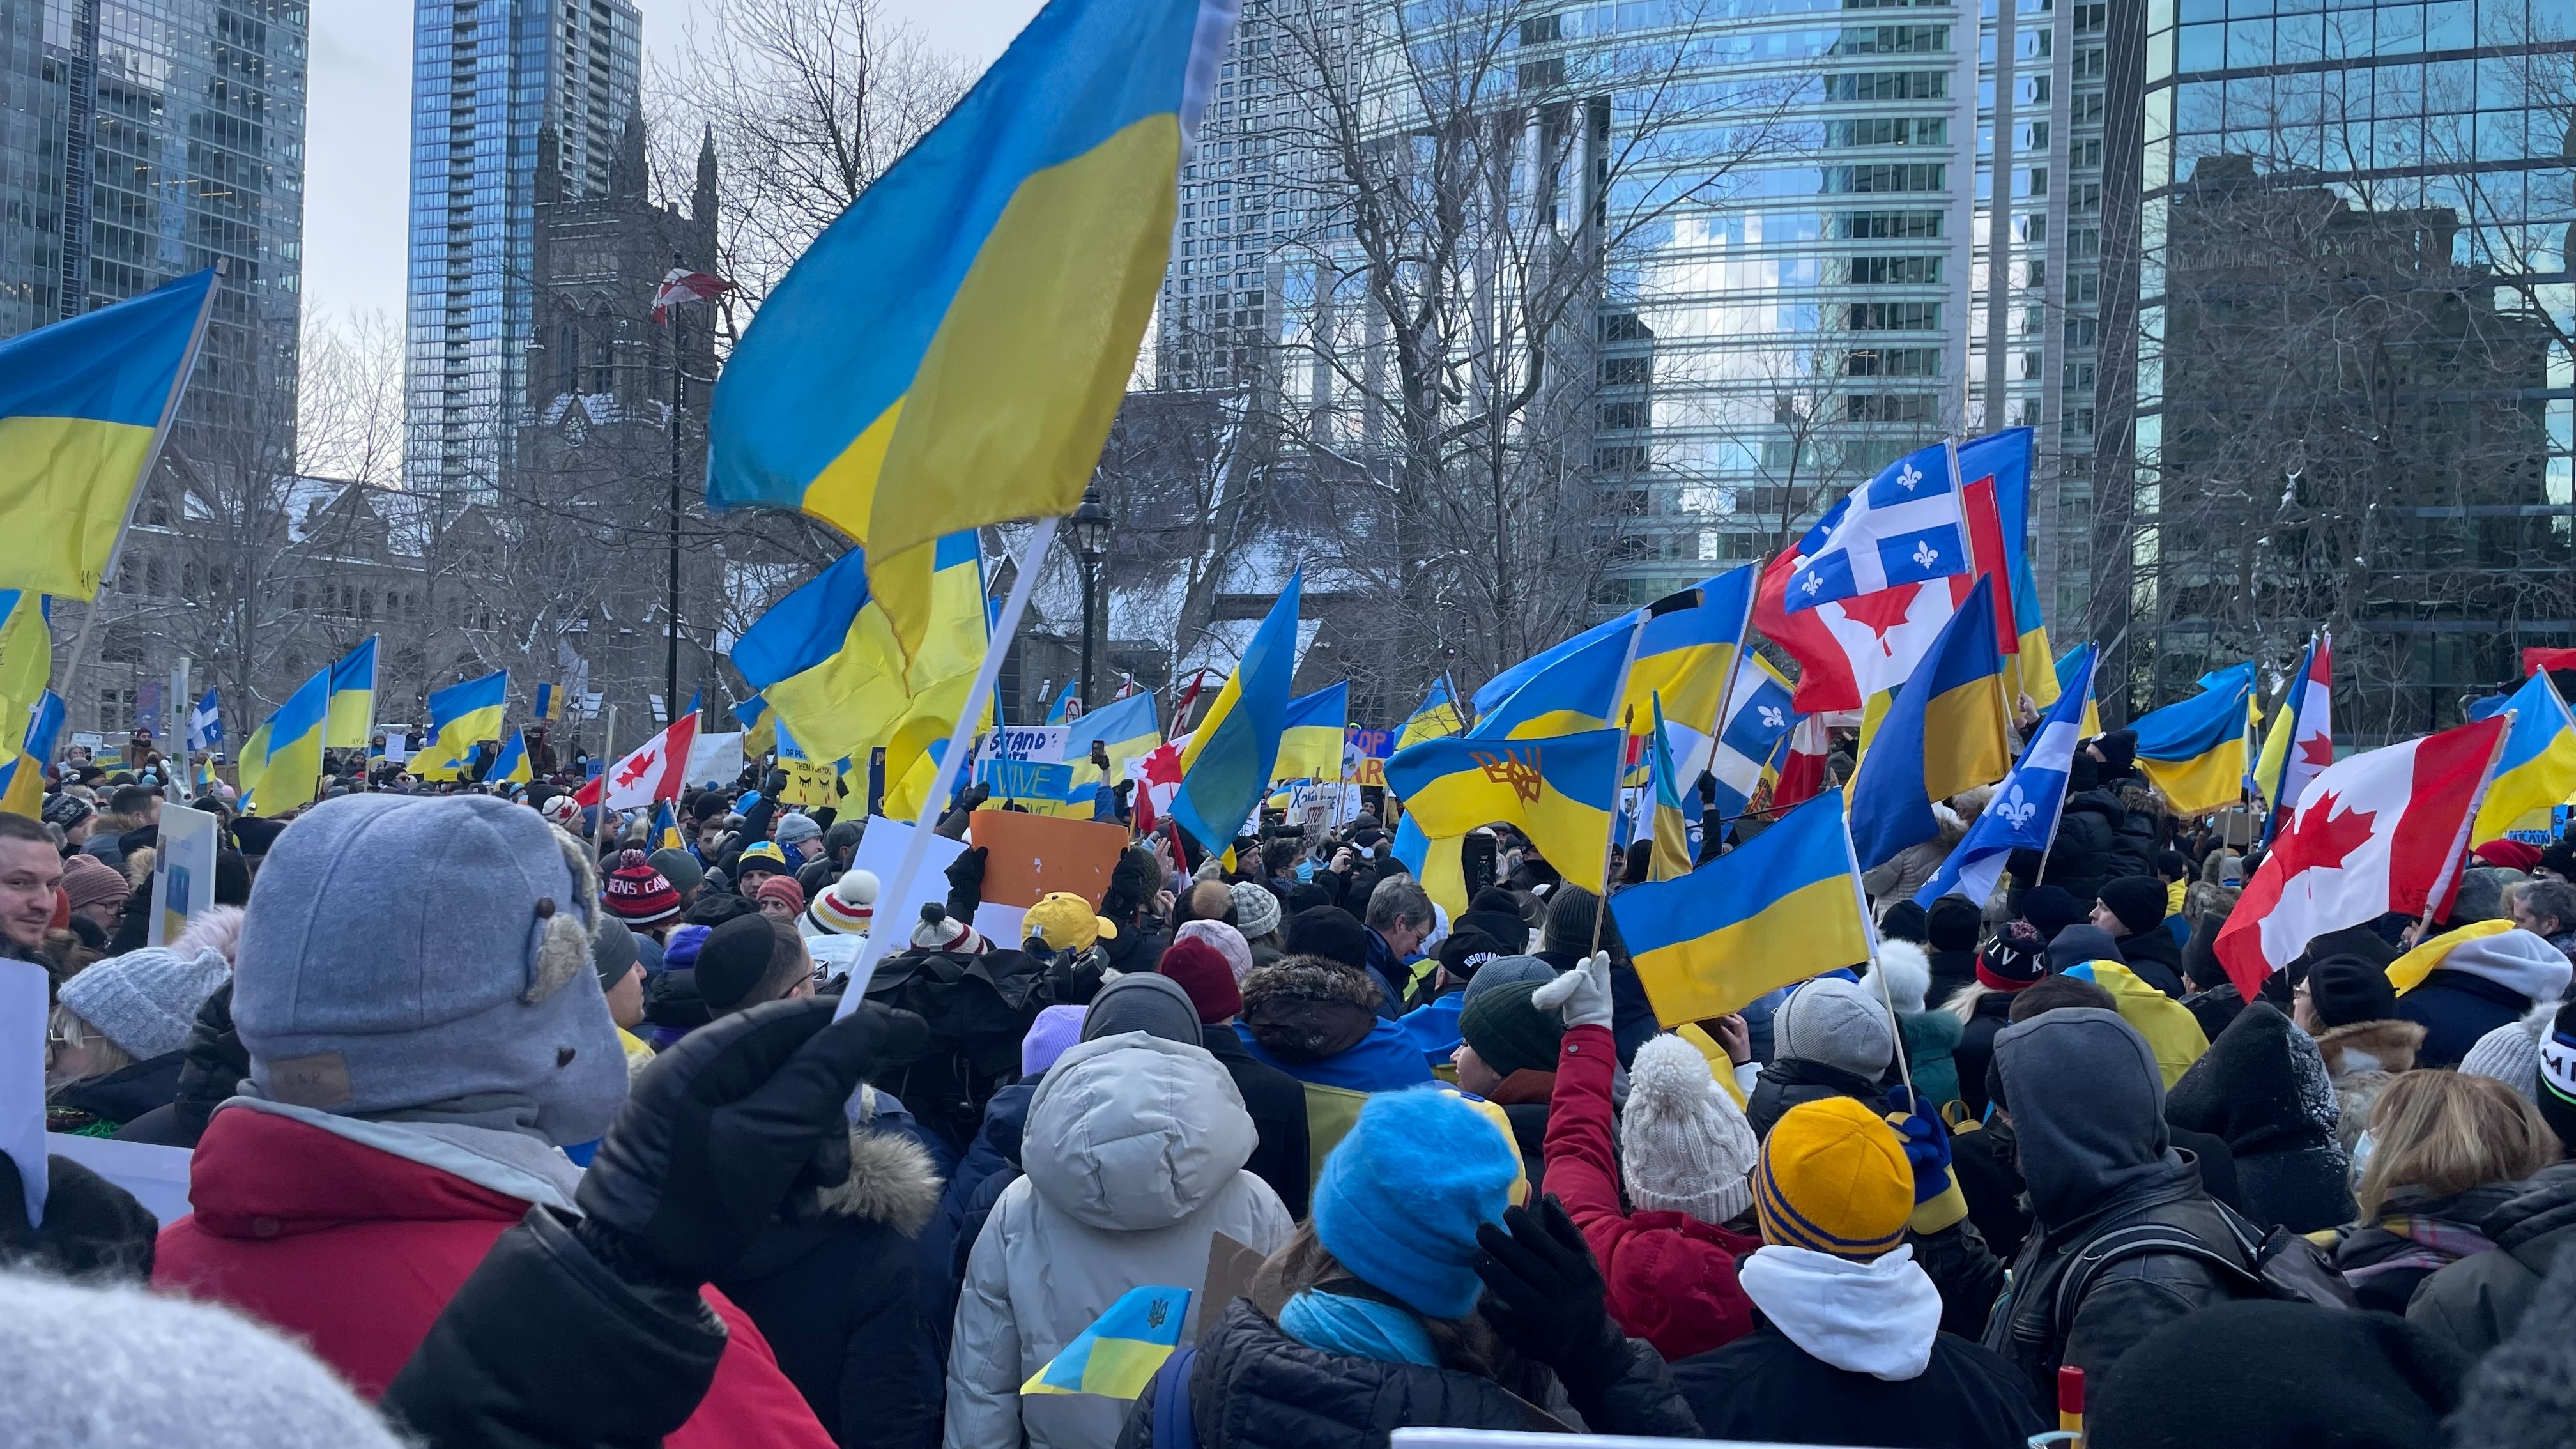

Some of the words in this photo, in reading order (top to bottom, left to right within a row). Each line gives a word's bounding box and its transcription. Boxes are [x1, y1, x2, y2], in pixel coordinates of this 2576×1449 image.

[786, 748, 794, 757] OR
[1345, 730, 1386, 756] TOP
[795, 762, 811, 772] THEM
[822, 766, 832, 776] YOU
[997, 764, 1053, 797] VIVE
